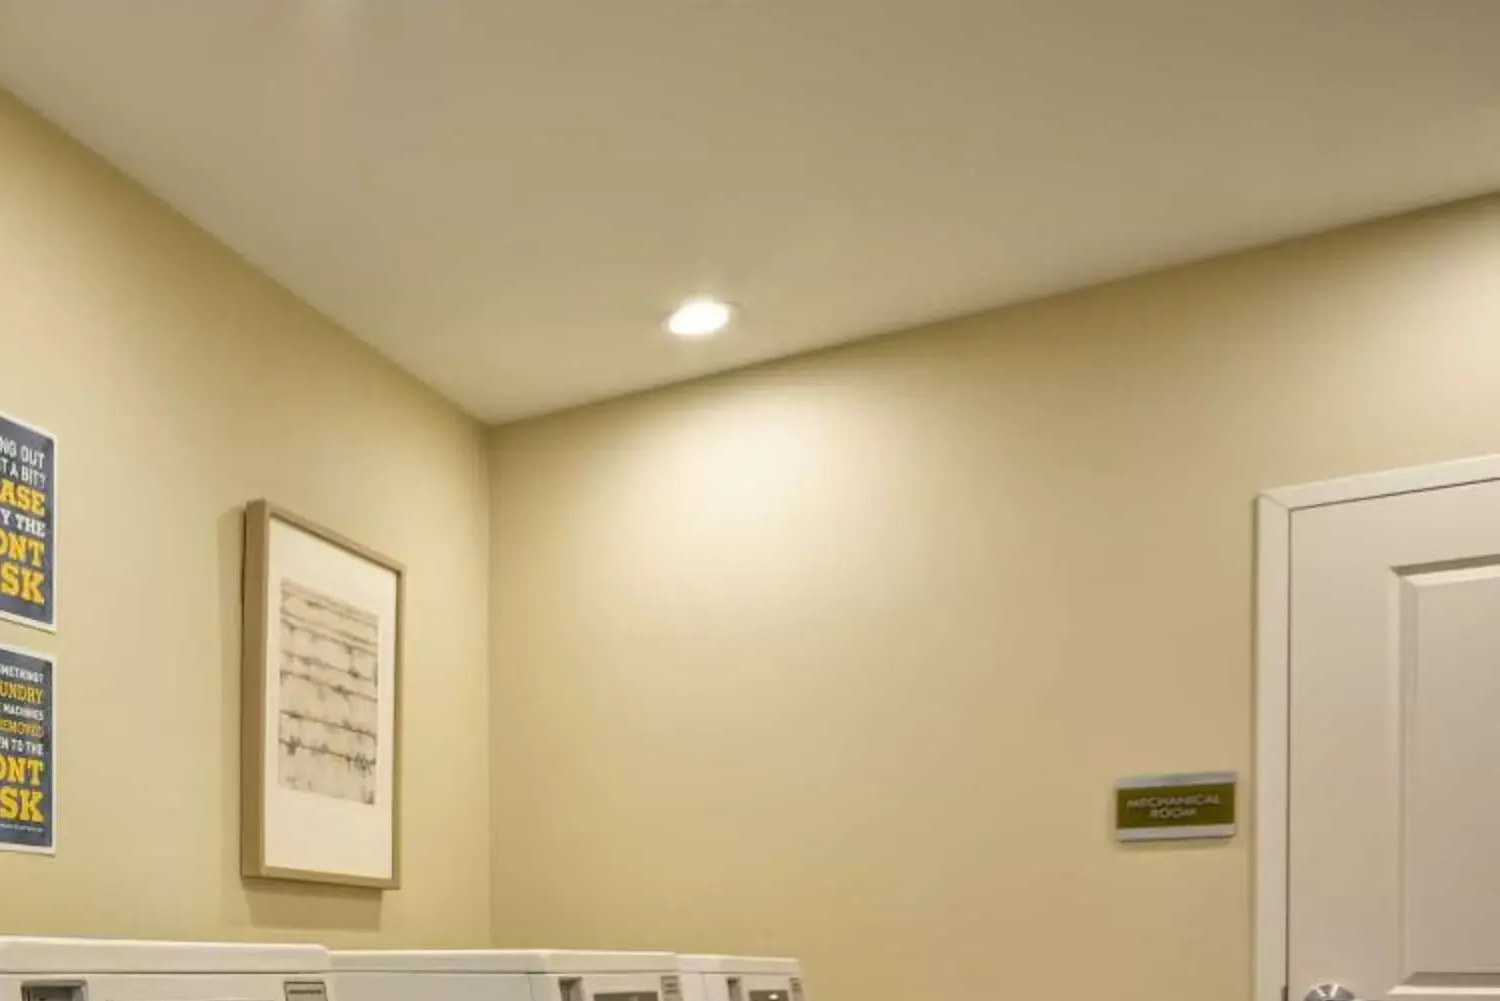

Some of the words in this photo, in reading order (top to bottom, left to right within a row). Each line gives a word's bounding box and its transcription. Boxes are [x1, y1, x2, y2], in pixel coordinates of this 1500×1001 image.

[21, 444, 45, 469] OUT
[10, 461, 19, 479] A
[21, 465, 46, 490] BIT?
[15, 513, 46, 539] THE
[11, 739, 24, 752] TO
[25, 741, 45, 757] THE
[1126, 794, 1221, 810] MECHANICAL
[1149, 807, 1198, 820] ROOM
